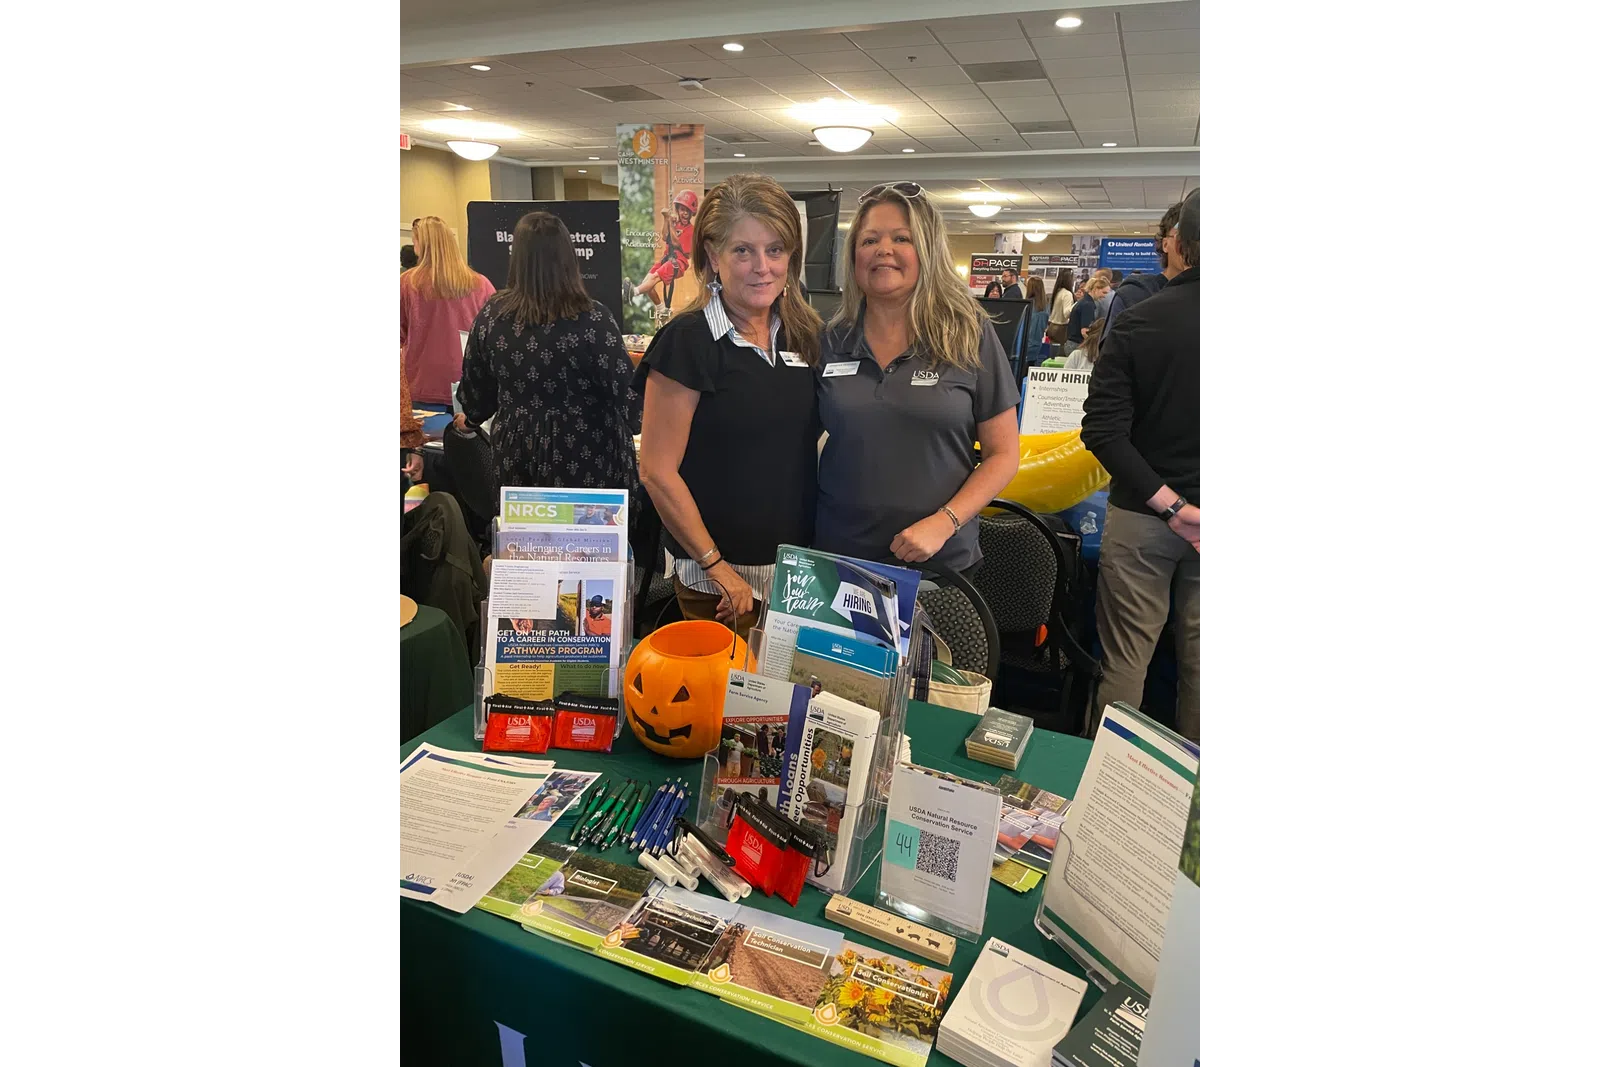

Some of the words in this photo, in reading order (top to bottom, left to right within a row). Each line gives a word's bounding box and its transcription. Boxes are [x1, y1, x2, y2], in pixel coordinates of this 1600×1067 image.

[496, 231, 514, 243] Bla
[570, 232, 606, 243] etreat
[625, 228, 660, 241] Encouraging
[574, 246, 594, 260] mp
[912, 370, 939, 379] USDA
[1030, 372, 1058, 382] NOW
[1061, 373, 1091, 384] HIRIN
[508, 504, 558, 517] NRCS
[507, 542, 563, 554] Challenging
[565, 543, 600, 553] Careers
[602, 543, 611, 554] in
[510, 552, 523, 560] the
[526, 553, 562, 561] Natural
[564, 554, 609, 562] Resources
[782, 570, 816, 598] join
[792, 587, 810, 598] our
[781, 596, 824, 616] team
[843, 593, 872, 614] HIRING
[558, 647, 603, 655] PROGRAM
[731, 673, 745, 681] USDA
[739, 692, 753, 700] Service
[810, 705, 824, 714] USDA
[508, 717, 531, 726] USDA
[573, 717, 596, 726] USDA
[984, 736, 1010, 748] USDA
[795, 728, 813, 802] Opportunities
[1127, 753, 1138, 764] Most
[1138, 761, 1158, 777] Effective
[1158, 774, 1178, 790] Resumes
[782, 753, 798, 797] Loans
[909, 806, 926, 816] USDA
[926, 810, 949, 822] Natural
[949, 816, 978, 830] Resource
[911, 814, 950, 829] Conservation
[951, 825, 973, 836] Service
[752, 814, 760, 823] First
[768, 827, 777, 838] First
[745, 830, 764, 854] USDA
[793, 834, 803, 843] First
[805, 842, 814, 850] Aid
[896, 833, 912, 857] 44
[414, 875, 435, 884] NRCS
[575, 874, 600, 886] Biologist
[684, 912, 711, 925] Technician
[552, 927, 572, 937] SERVICE
[750, 938, 784, 953] Technician
[754, 931, 766, 940] Soil
[767, 934, 811, 953] Conservation
[992, 941, 1010, 952] USDA
[599, 948, 635, 964] CONSERVATION
[636, 961, 655, 972] SERVICE
[857, 969, 871, 978] Soil
[873, 974, 929, 999] Conservationist
[1035, 968, 1055, 982] Department
[1060, 982, 1080, 994] Agriculture
[708, 985, 750, 1001] CONSERVATION
[751, 997, 774, 1010] SERVICE
[1124, 996, 1149, 1019] US
[1110, 1018, 1120, 1026] Farm
[1120, 1024, 1134, 1035] Service
[1112, 1014, 1135, 1031] Department
[817, 1026, 861, 1048] CONSERVATION
[862, 1042, 886, 1056] SERVICE
